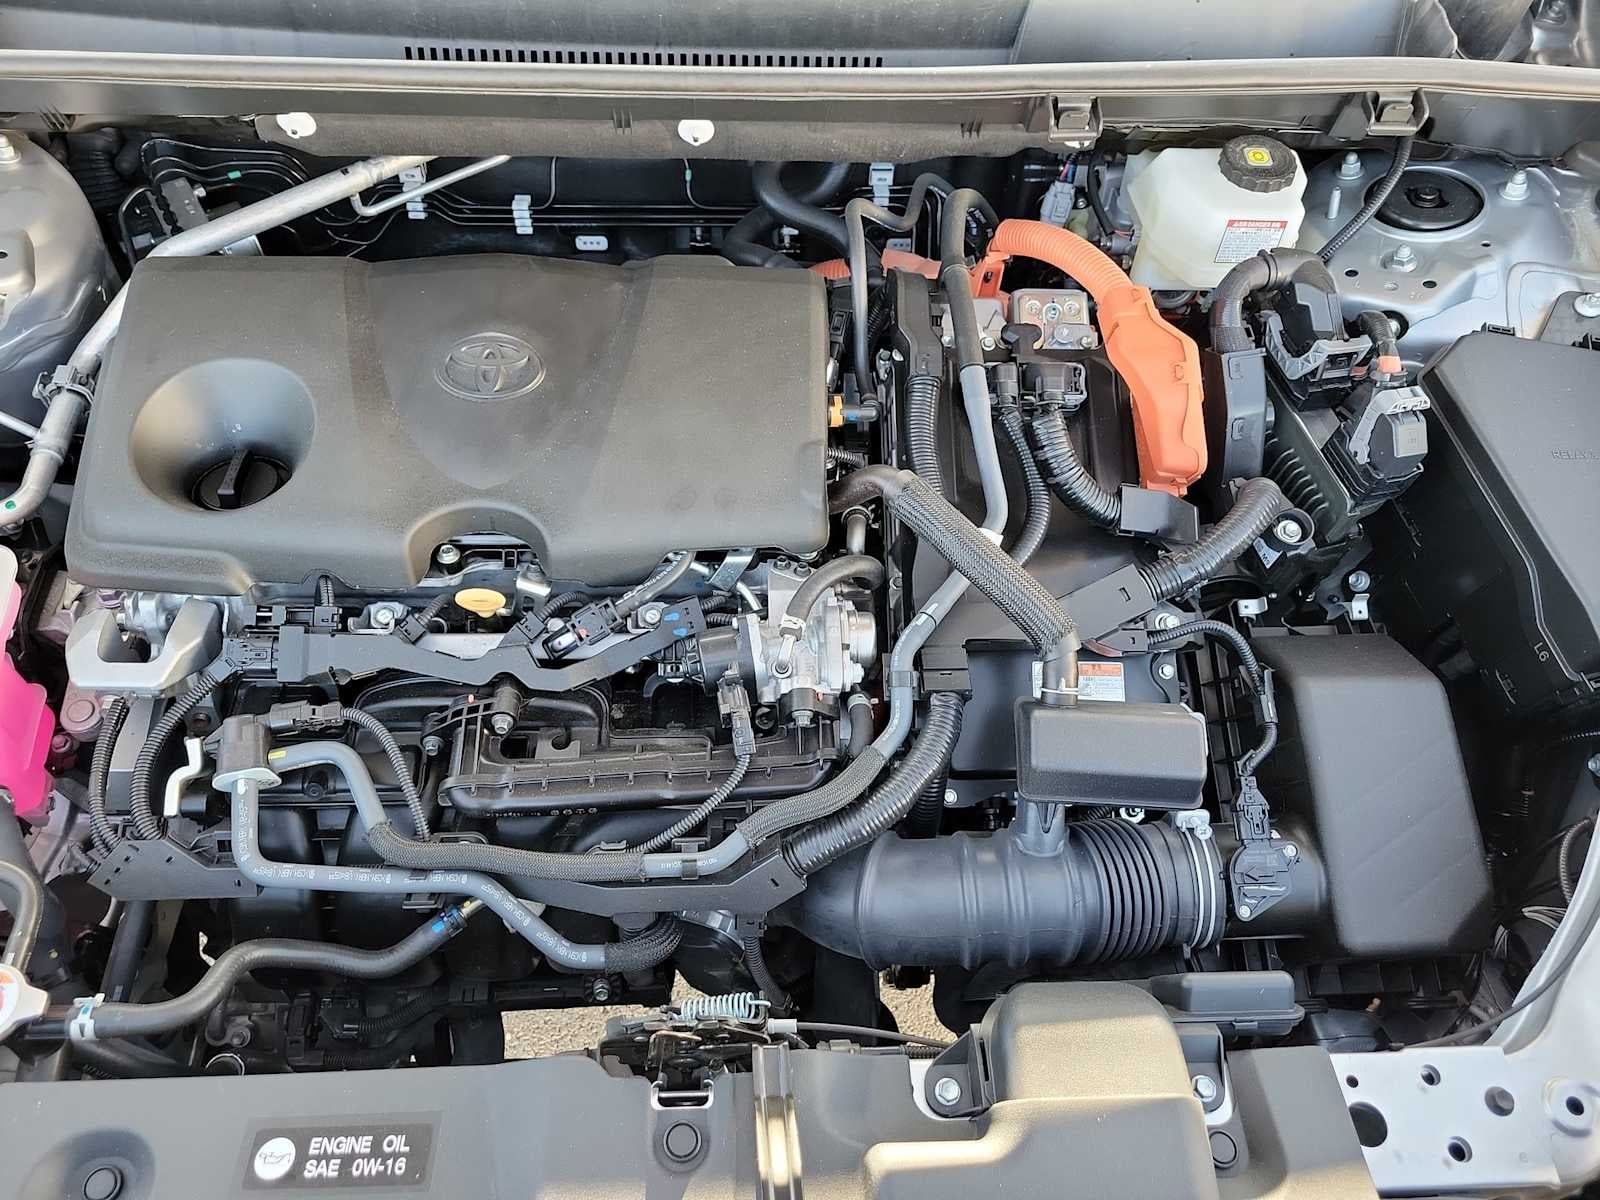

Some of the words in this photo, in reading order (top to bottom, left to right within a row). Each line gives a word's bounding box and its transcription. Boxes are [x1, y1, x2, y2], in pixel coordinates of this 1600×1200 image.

[308, 1135, 373, 1155] ENGINE
[382, 1134, 410, 1153] OIL
[303, 1159, 341, 1178] SAE
[351, 1157, 407, 1176] 0W-16
